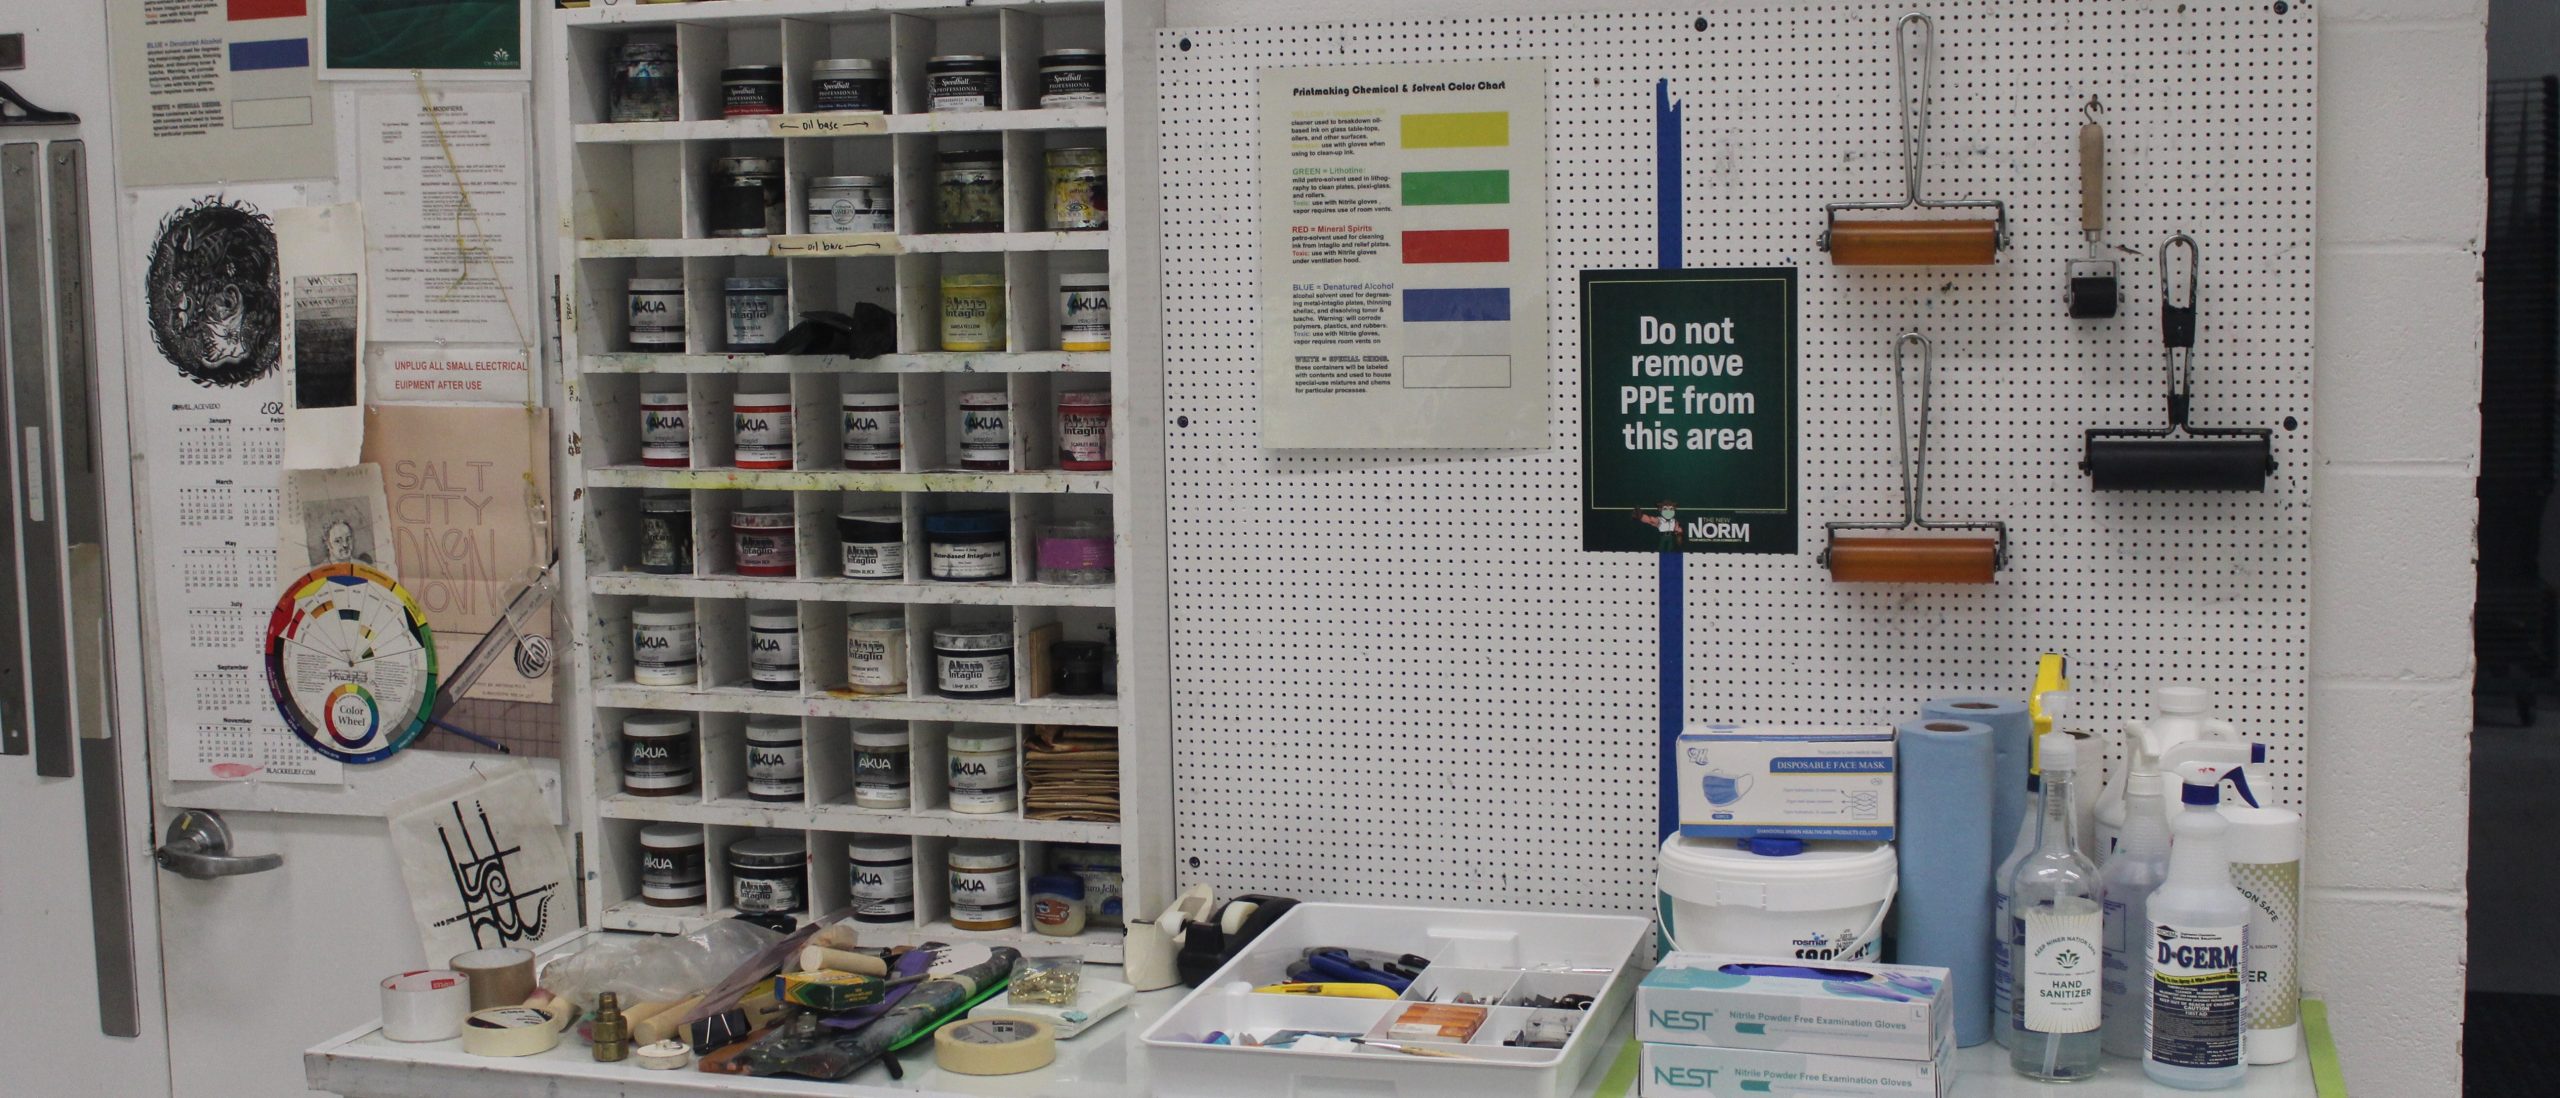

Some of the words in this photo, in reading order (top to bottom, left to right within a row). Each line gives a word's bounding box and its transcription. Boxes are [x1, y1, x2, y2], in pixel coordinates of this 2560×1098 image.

[1293, 87, 1350, 97] Printmaking
[1352, 84, 1398, 95] Chemical
[1402, 84, 1408, 93] &
[1412, 83, 1446, 93] Solvent
[1448, 82, 1475, 91] Color
[1477, 81, 1506, 90] Chart
[802, 119, 813, 131] oil
[816, 119, 838, 130] base
[1292, 168, 1321, 176] GREEN
[1317, 225, 1346, 233] Mineral
[1347, 224, 1372, 233] Spirits
[808, 241, 818, 252] oil
[634, 300, 667, 313] AKUA
[1071, 297, 1108, 311] AKUA
[945, 308, 985, 319] Intaglio
[1640, 315, 1676, 345] Do
[1685, 317, 1734, 345] not
[395, 361, 427, 371] UNPLUG
[430, 361, 444, 371] ALL
[446, 361, 474, 371] SMALL
[475, 362, 528, 371] ELECTRICAL
[1632, 354, 1744, 377] remove
[395, 380, 435, 390] EUIPMENT
[438, 380, 464, 390] AFTER
[466, 380, 482, 390] USE
[1621, 385, 1674, 414] PPE
[1682, 385, 1755, 414] from
[652, 416, 685, 429] AKUA
[737, 418, 769, 432] AKUA
[847, 417, 879, 430] AKUA
[969, 416, 1004, 430] AKUA
[1064, 427, 1105, 436] Intaglio
[1622, 421, 1679, 450] this
[1686, 428, 1753, 450] area
[396, 460, 494, 492] SALT
[396, 494, 494, 525] CITY
[1688, 518, 1750, 542] NORM
[847, 556, 876, 565] Intaglio
[966, 552, 991, 560] Intaglio
[638, 636, 669, 649] AKUA
[752, 637, 780, 651] AKUA
[950, 671, 982, 680] Intaglio
[339, 704, 364, 715] Color
[338, 715, 365, 726] Wheel
[633, 746, 668, 758] AKUA
[751, 753, 784, 766] AKUA
[858, 758, 891, 770] AKUA
[1777, 761, 1834, 769] DISPOSABLE
[1834, 761, 1857, 769] FACE
[1858, 761, 1885, 769] MASK
[954, 762, 986, 775] AKUA
[644, 858, 673, 869] AKUA
[2259, 901, 2279, 922] SAFE
[2066, 936, 2088, 945] NATION
[2052, 980, 2082, 988] HAND
[2040, 988, 2092, 998] SANITIZER
[1649, 1009, 1714, 1031] NEST
[1729, 1011, 1756, 1020] Nitrile
[1758, 1012, 1792, 1023] Powder
[1794, 1014, 1814, 1024] Free
[1816, 1015, 1873, 1027] Examination
[1875, 1019, 1906, 1030] Gloves
[1915, 1010, 1922, 1018] L
[1654, 1066, 1718, 1088] NEST
[1734, 1068, 1761, 1078] Nitrile
[1763, 1070, 1796, 1080] Powder
[1798, 1071, 1819, 1081] Free
[1821, 1072, 1877, 1085] Examination
[1880, 1076, 1912, 1088] Gloves
[1920, 1067, 1927, 1076] M
